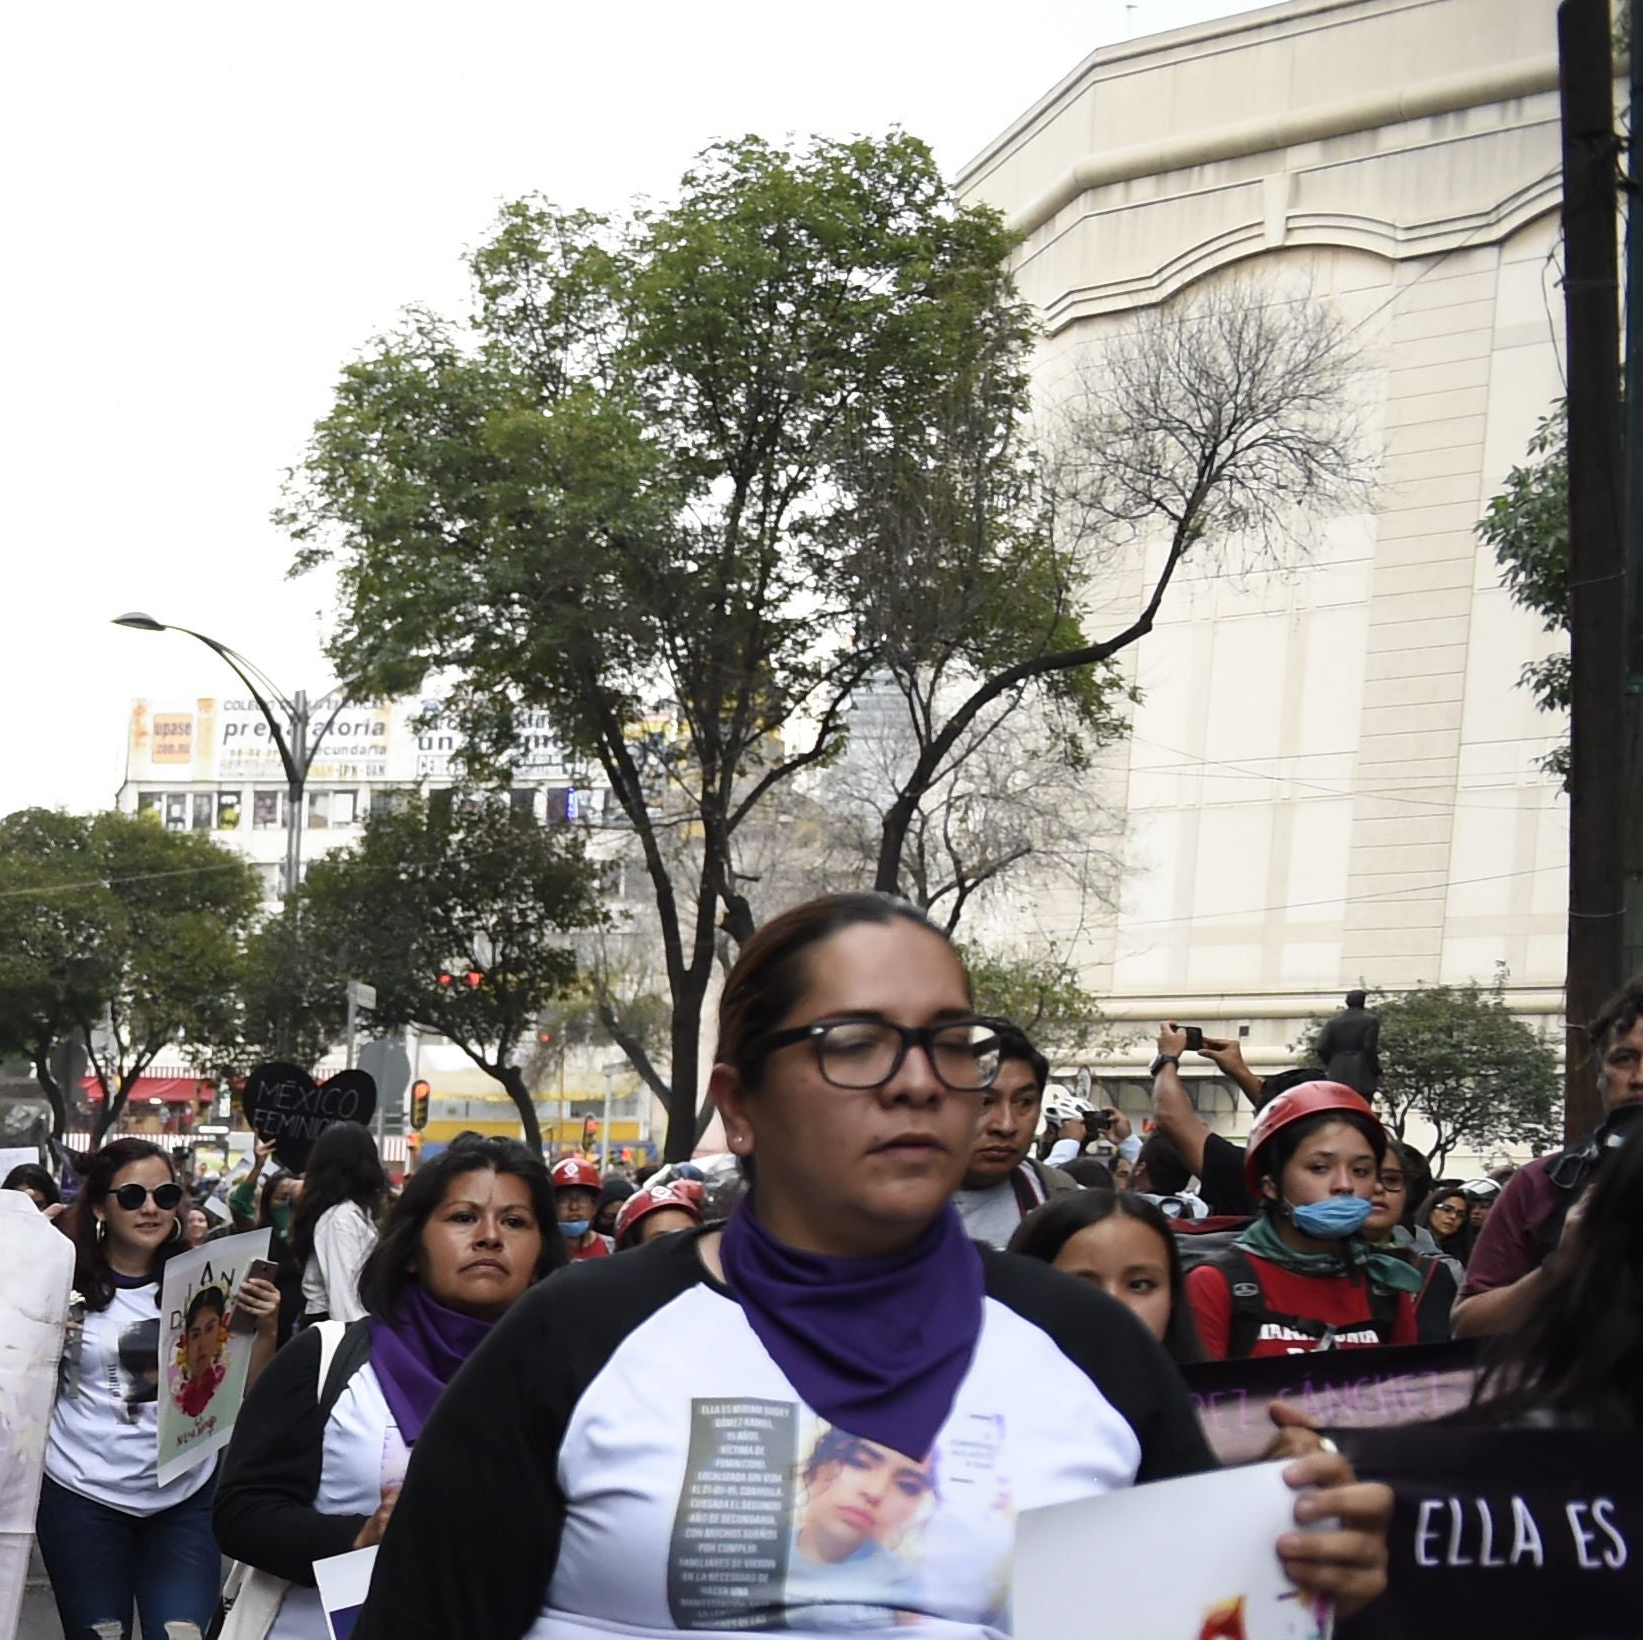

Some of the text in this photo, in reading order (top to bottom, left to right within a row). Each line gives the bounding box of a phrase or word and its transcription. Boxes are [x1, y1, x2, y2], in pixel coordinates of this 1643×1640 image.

[256, 1080, 359, 1119] MÉXICO
[1415, 1497, 1628, 1569] ELLA ES
